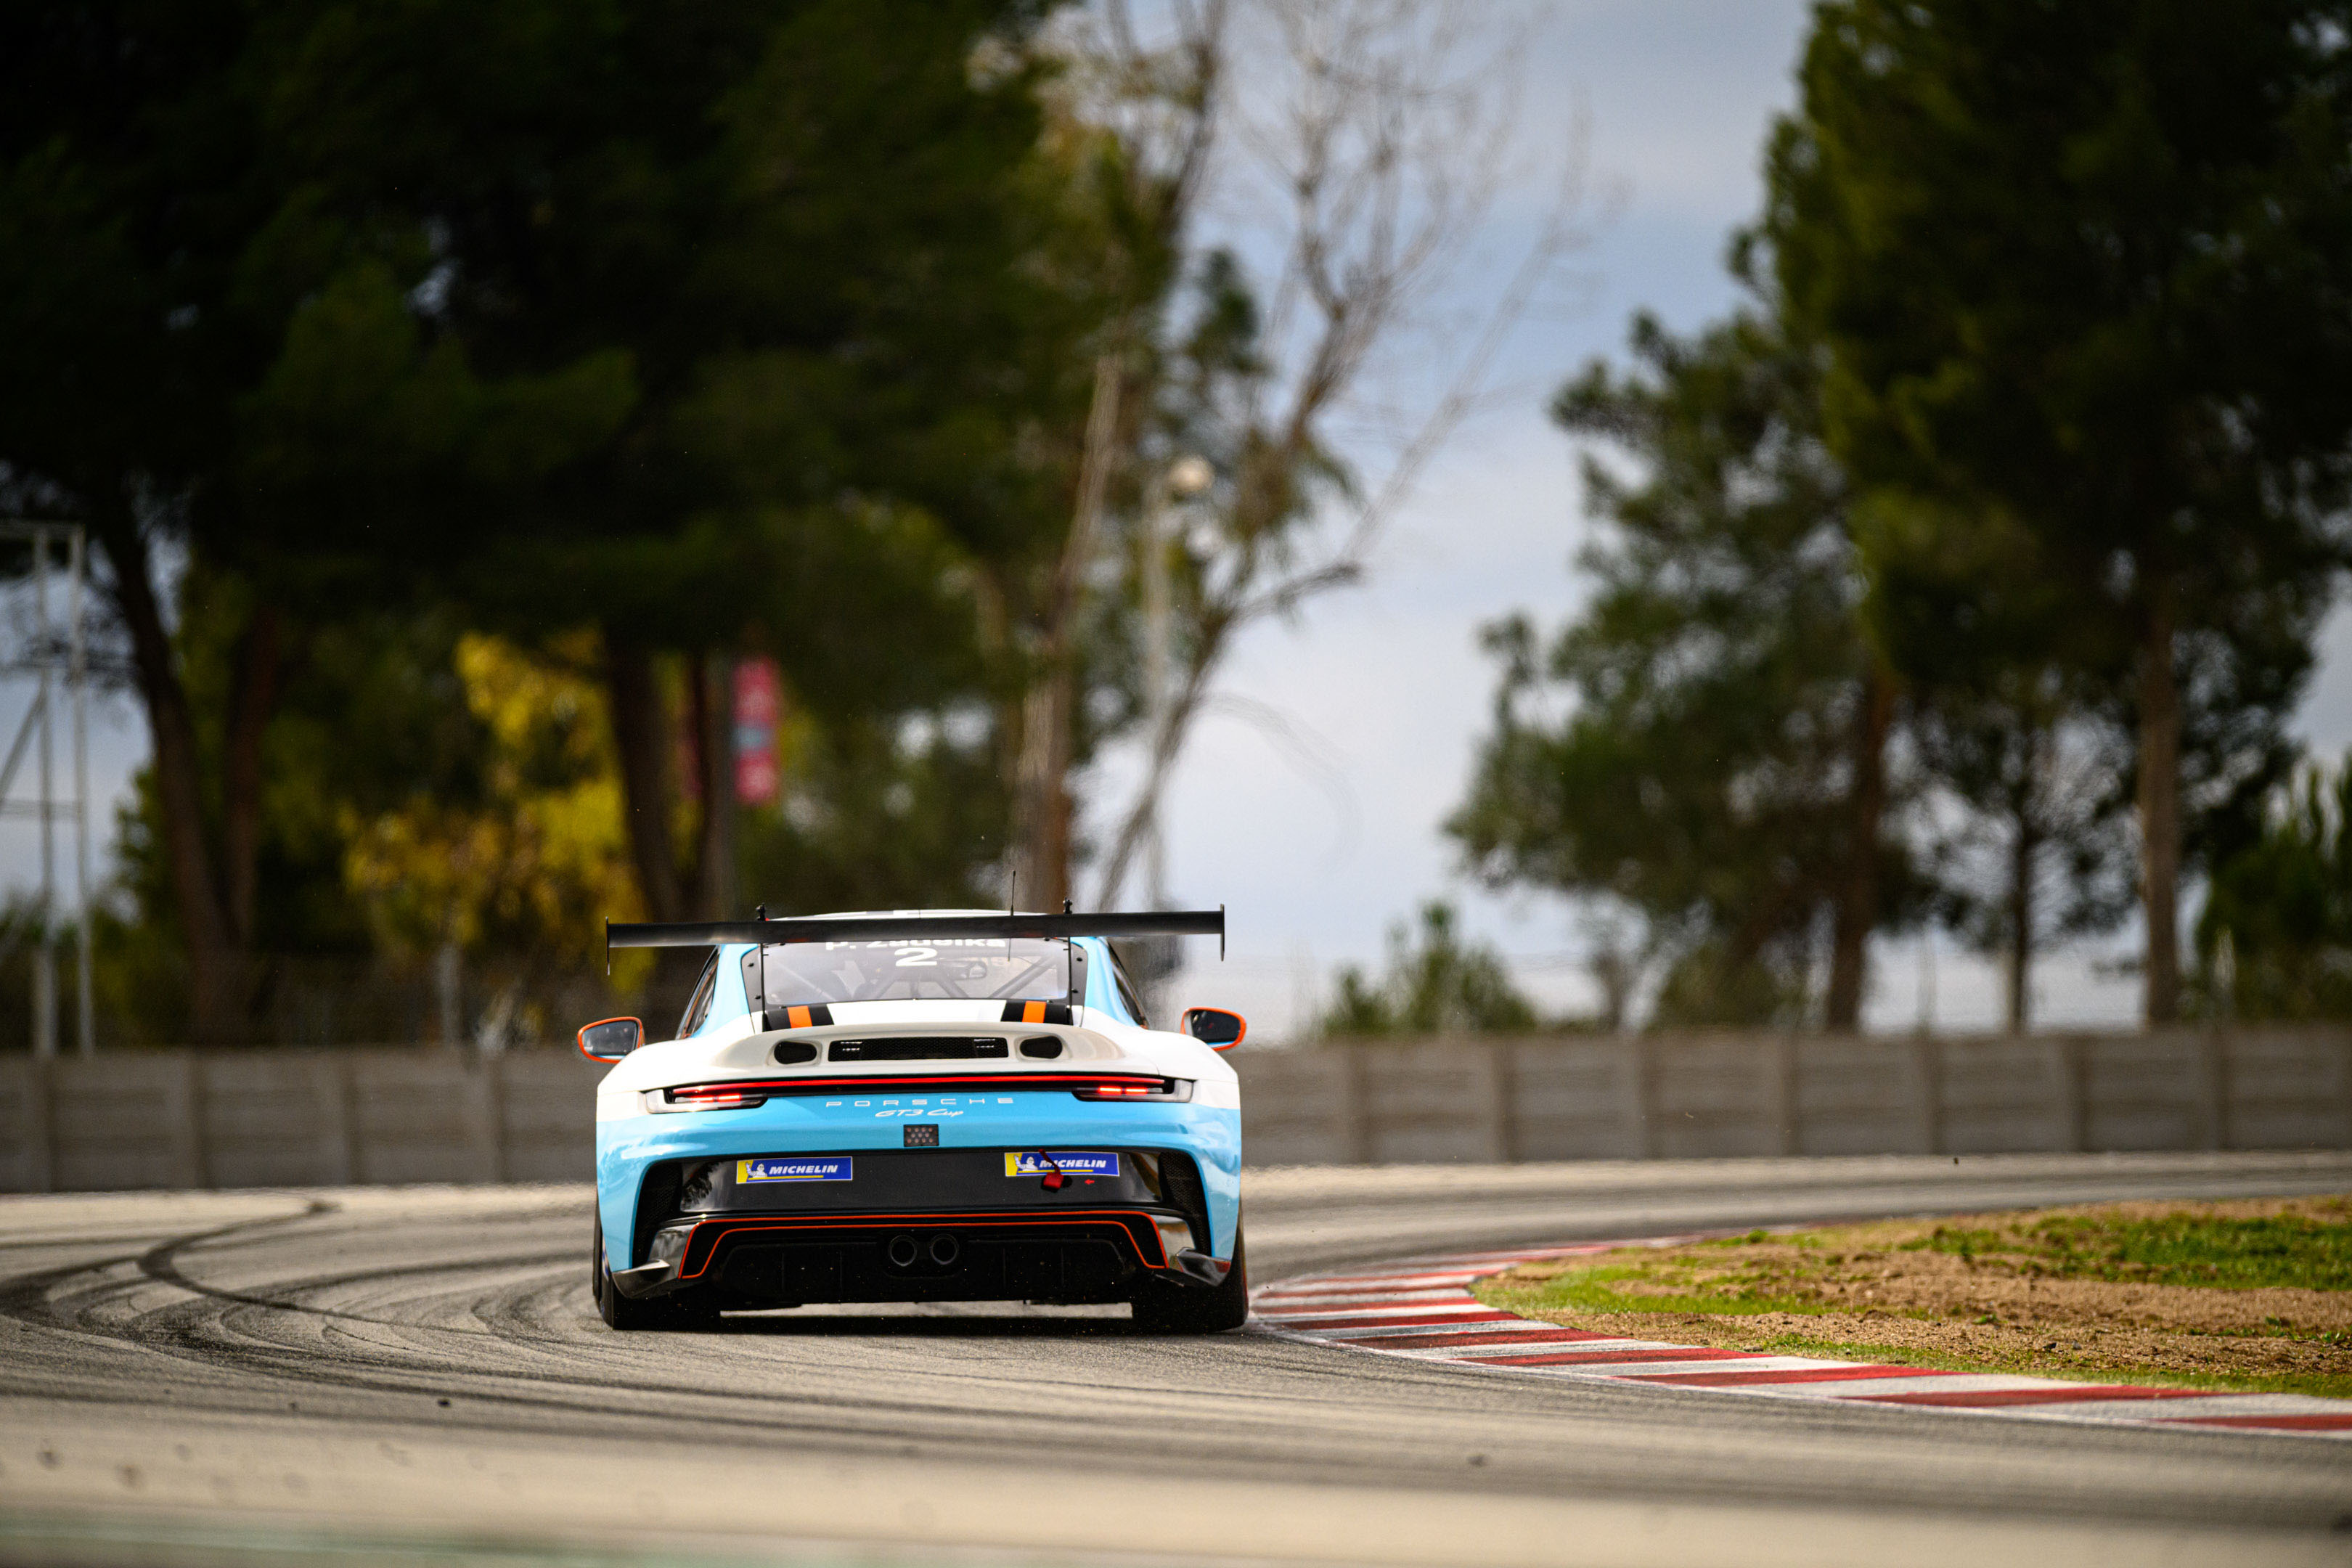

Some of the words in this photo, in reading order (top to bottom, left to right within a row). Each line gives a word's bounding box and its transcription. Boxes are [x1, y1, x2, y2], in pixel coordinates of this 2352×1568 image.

[894, 947, 938, 967] 2
[825, 1097, 1014, 1108] PORSCHE
[875, 1108, 924, 1117] GT3
[927, 1108, 964, 1117] Cup
[769, 1164, 838, 1175] MICHELIN
